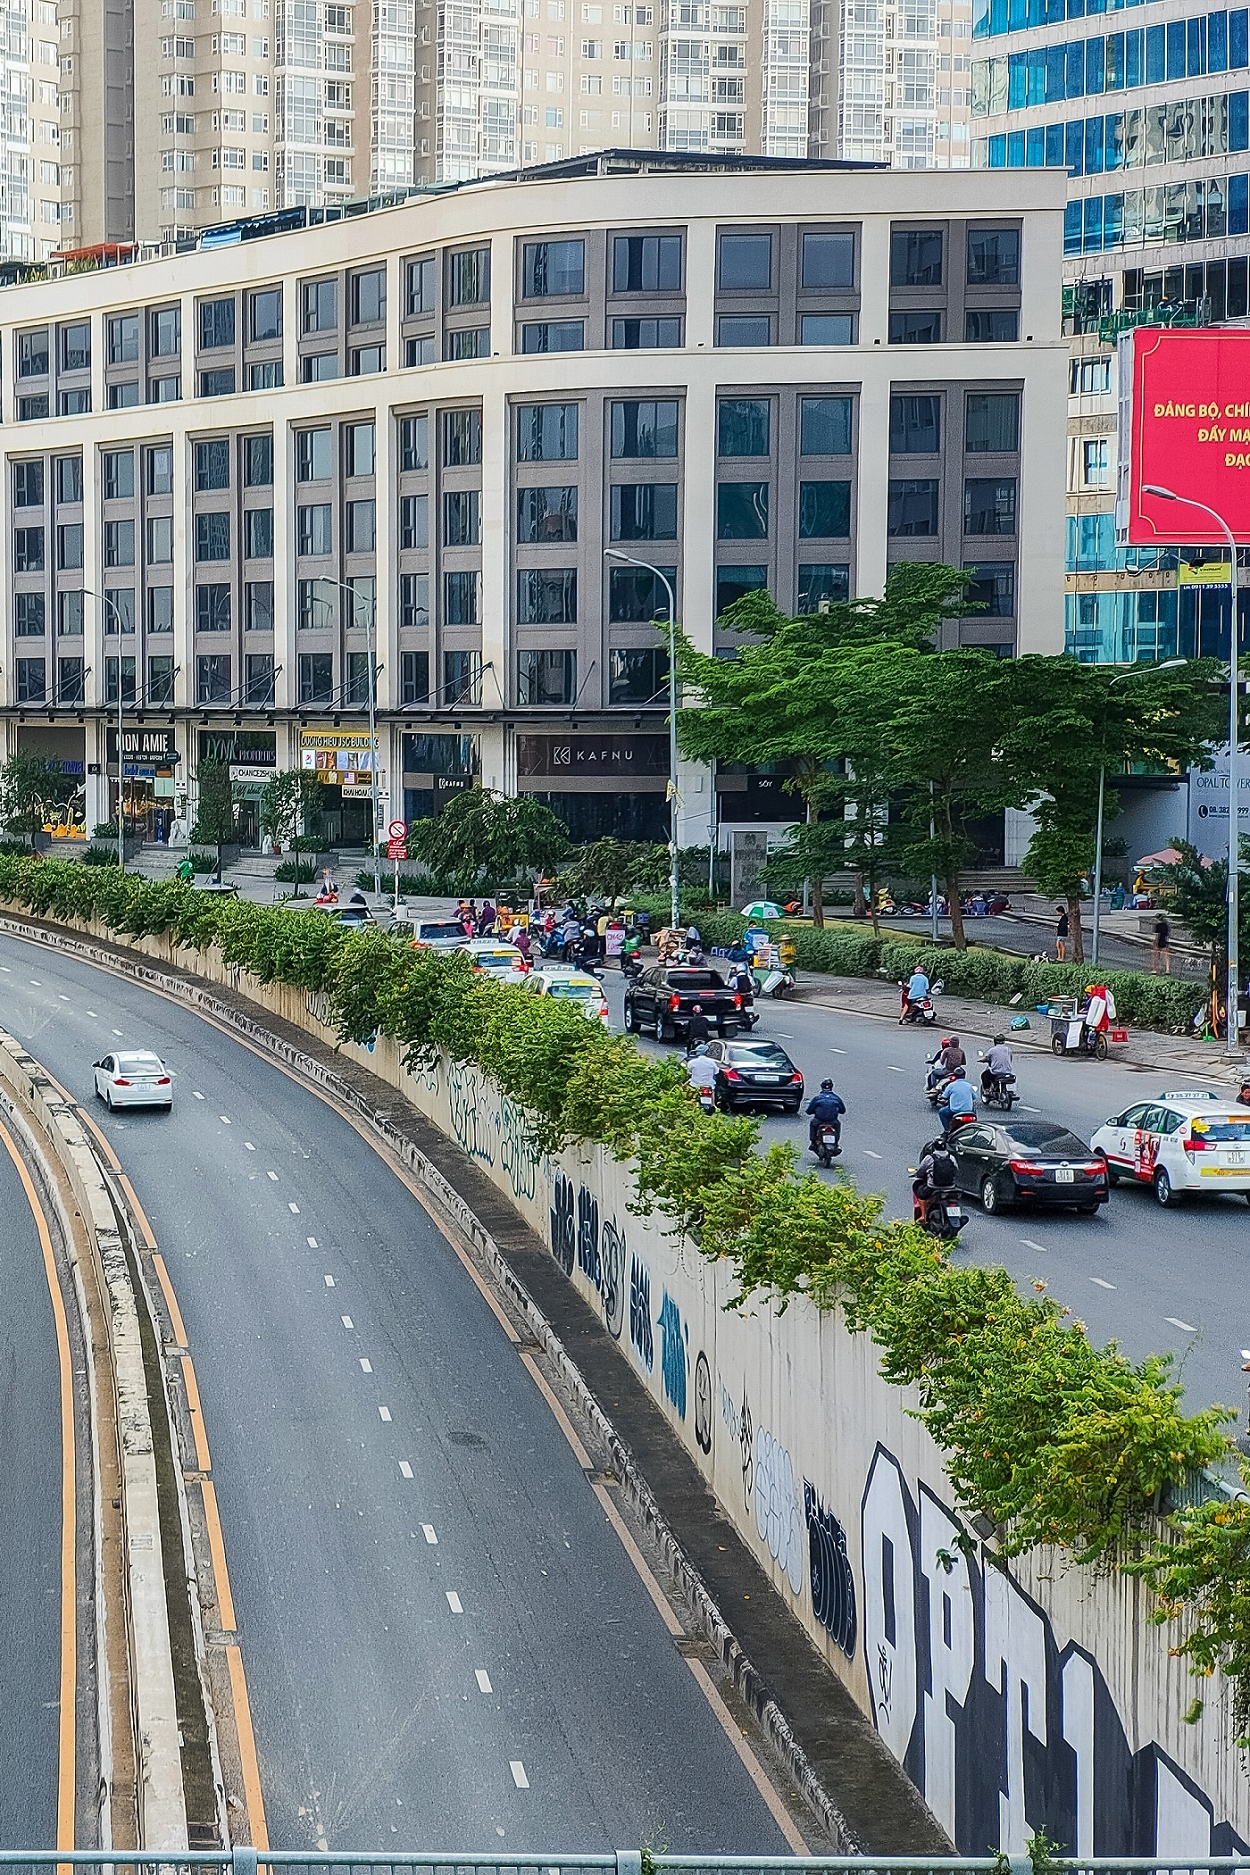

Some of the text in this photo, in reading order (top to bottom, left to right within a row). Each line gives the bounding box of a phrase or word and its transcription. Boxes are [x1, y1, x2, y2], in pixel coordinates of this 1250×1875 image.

[1154, 400, 1250, 420] ĐẢNG BỘ, CHÍ
[142, 734, 168, 752] AMIE
[576, 750, 633, 761] KAFNU
[1196, 777, 1219, 789] OPAL
